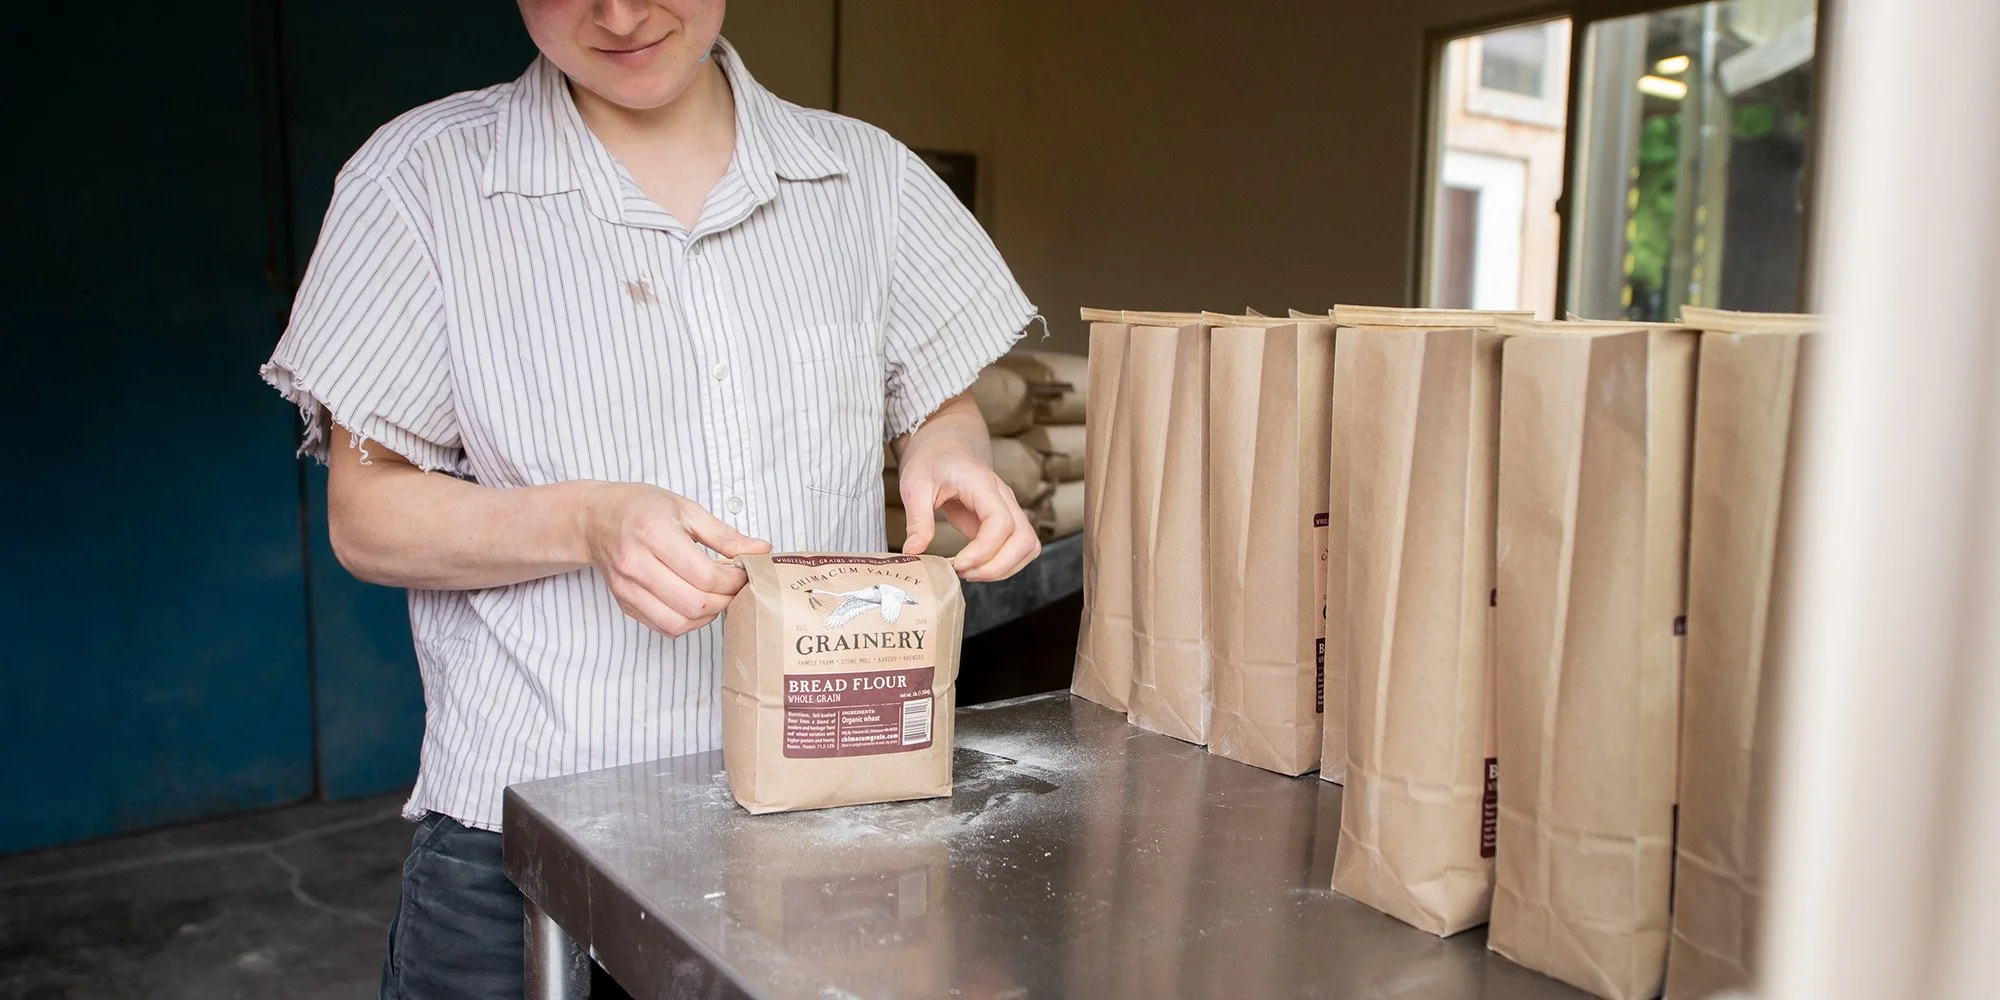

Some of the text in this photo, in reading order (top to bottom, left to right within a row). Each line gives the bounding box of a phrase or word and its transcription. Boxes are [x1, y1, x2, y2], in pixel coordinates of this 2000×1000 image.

[776, 558, 816, 566] WHOLESOME
[790, 567, 922, 591] CHIMACUM VALLEY
[796, 630, 926, 656] GRAINERY
[798, 659, 817, 667] FAMILY
[788, 675, 907, 694] BREAD FLOUR
[788, 693, 841, 704] WHOLE GRAIN
[841, 716, 863, 725] Organic
[841, 733, 898, 743] chimacumgrain.com
